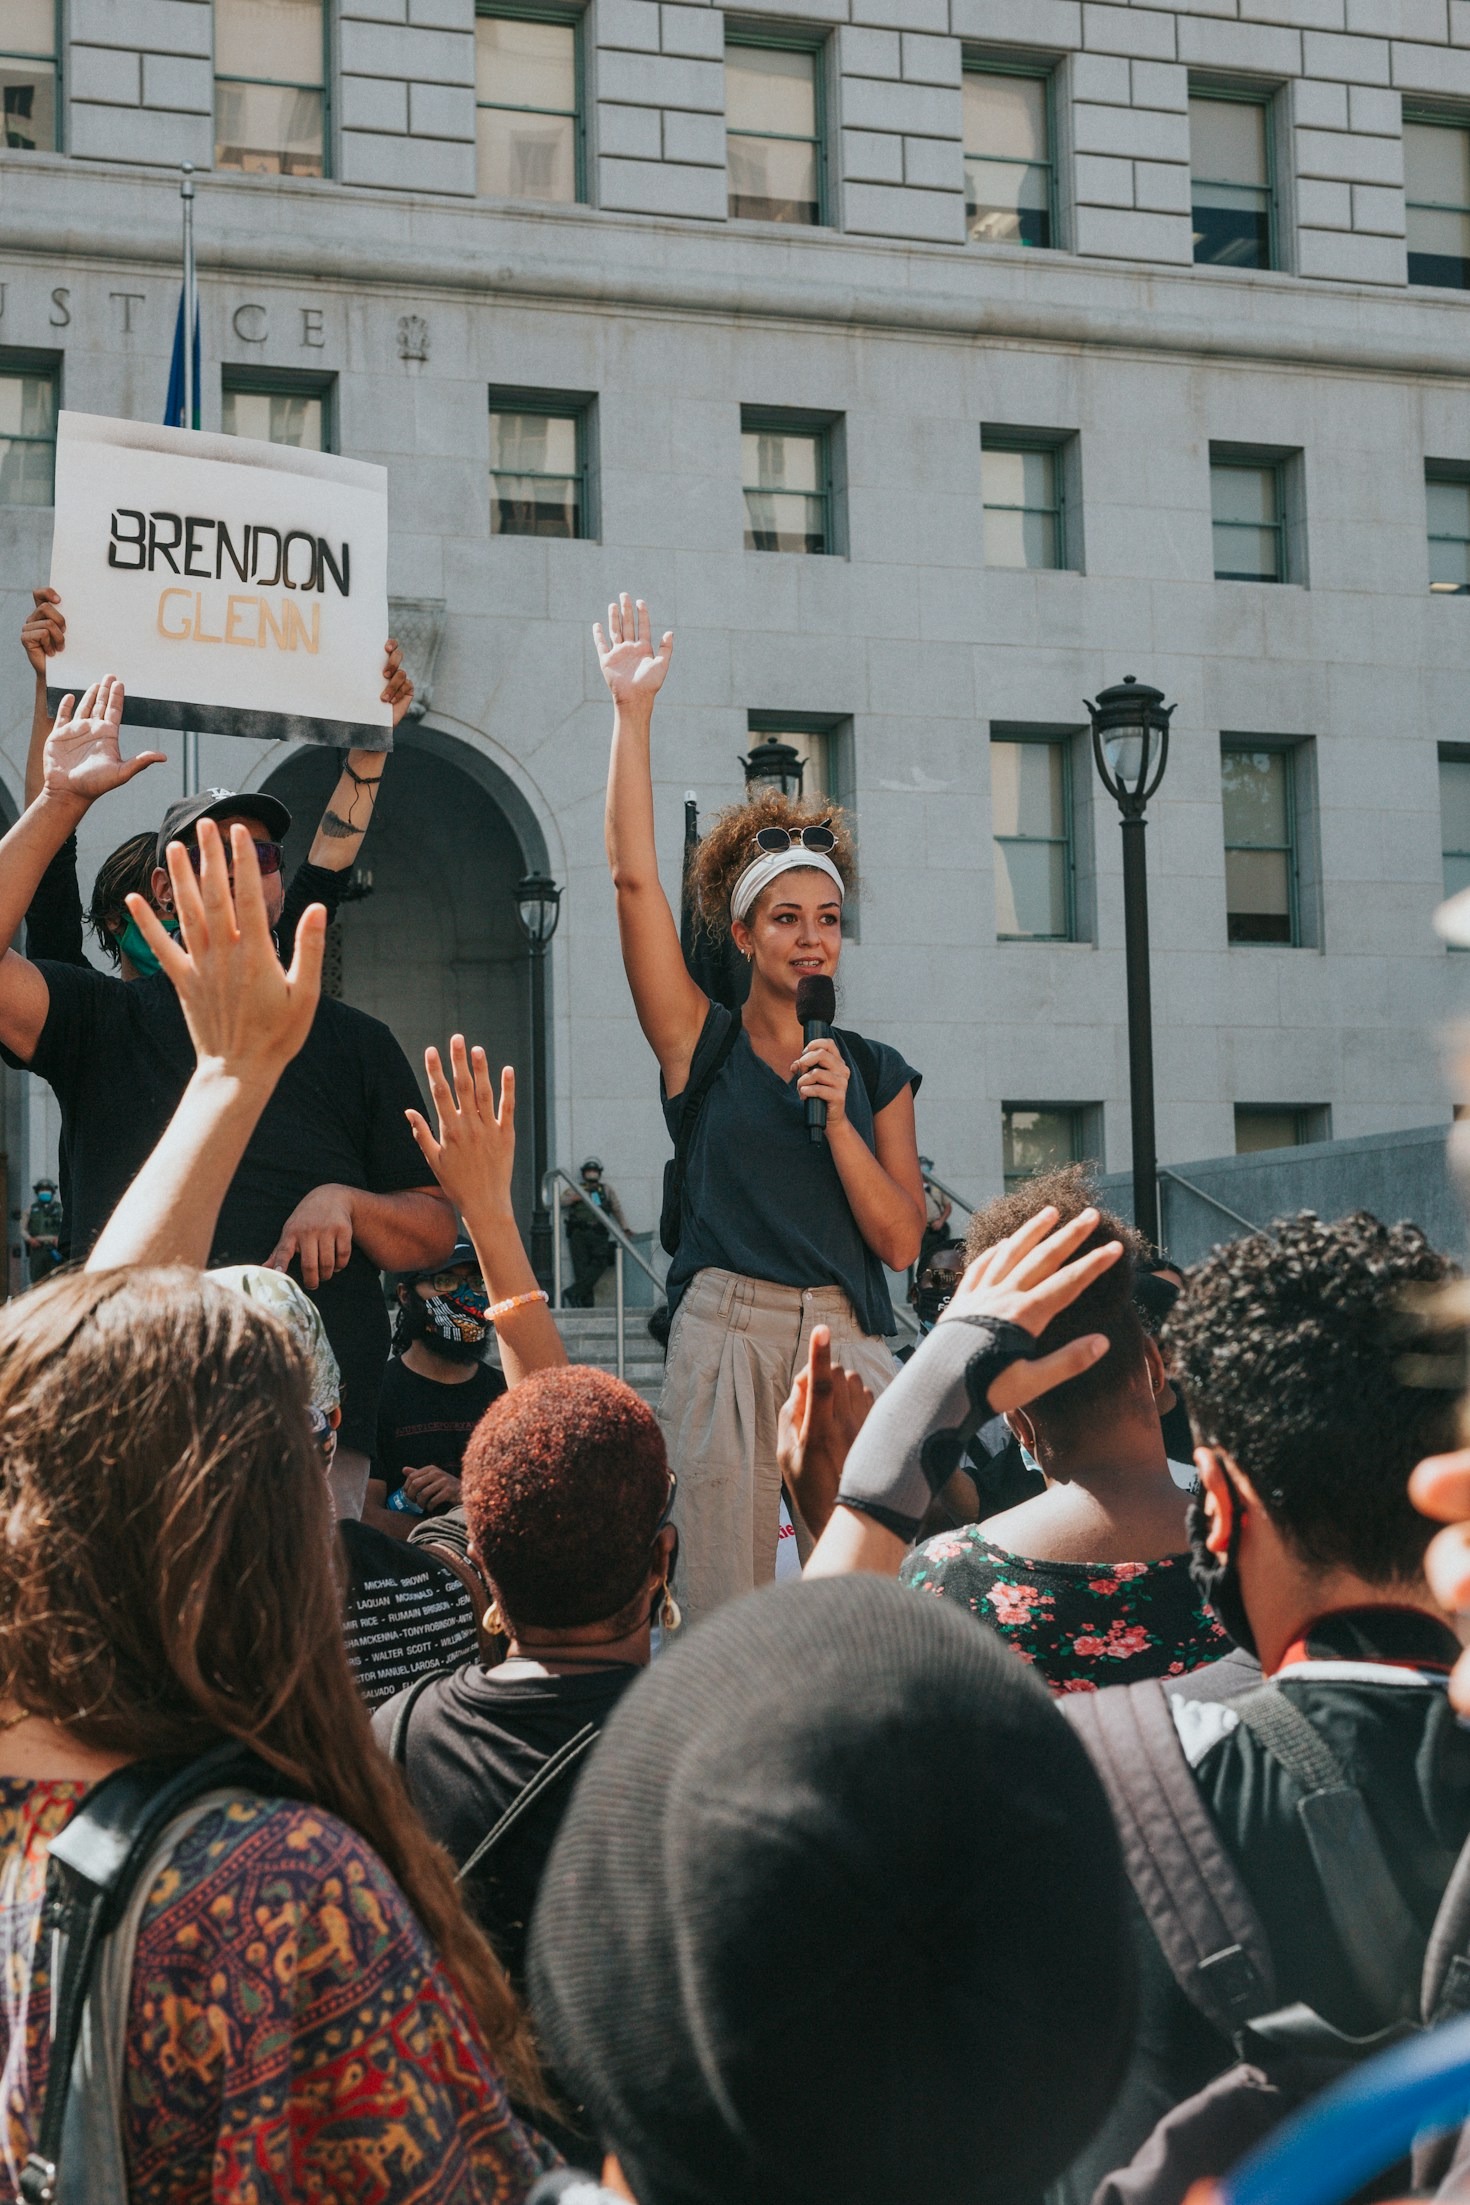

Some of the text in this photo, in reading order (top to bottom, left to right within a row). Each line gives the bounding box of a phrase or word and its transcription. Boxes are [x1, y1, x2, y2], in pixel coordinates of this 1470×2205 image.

[0, 283, 326, 348] STCE
[108, 508, 349, 597] BRENDON
[157, 587, 320, 655] GLENN
[364, 1578, 398, 1591] MICHAEL
[400, 1572, 430, 1588] BROWN
[356, 1596, 391, 1610] LAQUAN
[360, 1616, 379, 1627] RICE
[388, 1608, 422, 1623] RUMAIN
[371, 1649, 404, 1663] WALTER
[406, 1641, 432, 1656] SCOTT
[377, 1665, 410, 1679] MANUEL
[411, 1658, 440, 1673] LAROSA
